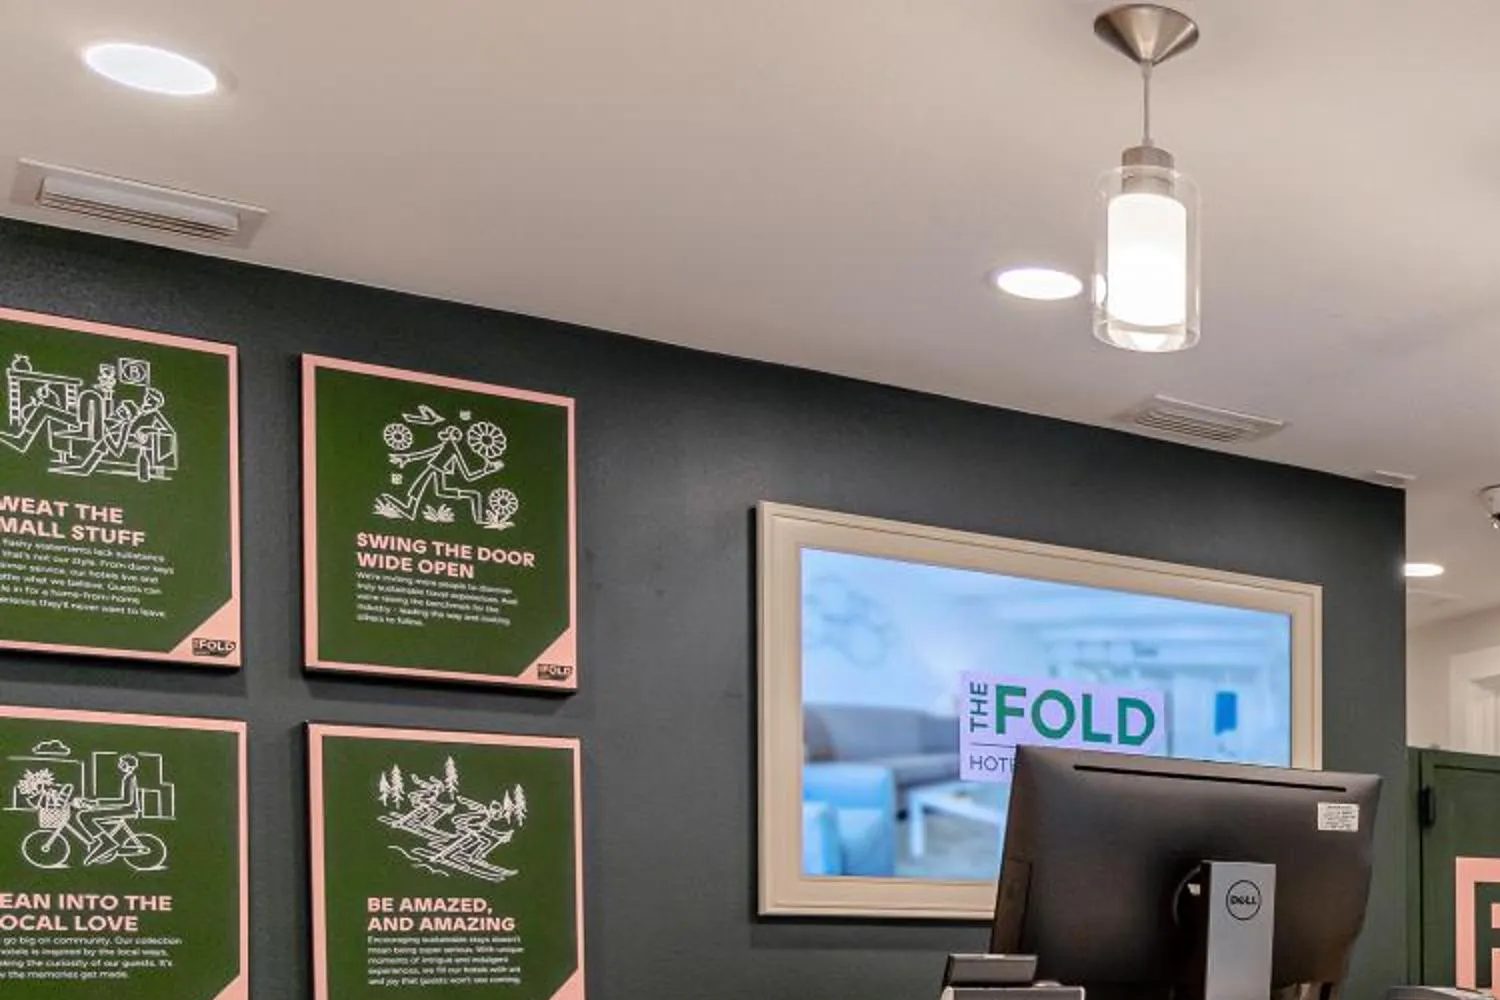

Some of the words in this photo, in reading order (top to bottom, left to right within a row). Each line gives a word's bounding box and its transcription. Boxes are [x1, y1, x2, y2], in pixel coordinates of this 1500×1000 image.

[0, 496, 69, 518] WEAT
[74, 503, 124, 524] THE
[0, 516, 65, 539] MALL
[71, 525, 146, 547] STUFF
[356, 532, 428, 554] SWING
[431, 541, 473, 560] THE
[477, 547, 536, 568] DOOR
[101, 560, 126, 569] From
[356, 552, 413, 572] WIDE
[418, 559, 475, 579] OPEN
[89, 570, 119, 580] hotels
[25, 586, 39, 595] for
[199, 639, 236, 651] FOLD
[970, 681, 988, 733] THE
[995, 684, 1155, 746] FOLD
[969, 755, 1015, 772] HOT
[0, 893, 51, 910] EAN
[58, 893, 119, 911] INTO
[124, 895, 173, 911] THE
[367, 897, 394, 912] BE
[400, 897, 493, 915] AMAZED,
[0, 914, 68, 931] OCAL
[75, 915, 139, 931] LOVE
[367, 917, 414, 932] AND
[419, 917, 516, 932] AMAZING
[4, 937, 17, 946] go
[20, 936, 37, 947] big
[53, 937, 112, 947] community.
[115, 936, 133, 945] Our
[135, 936, 182, 945] collection
[368, 936, 420, 946] Encouraging
[83, 948, 97, 958] by
[117, 948, 141, 956] local
[45, 960, 88, 969] curiosity
[368, 957, 408, 965] moments
[409, 957, 420, 965] of
[8, 971, 25, 979] the
[27, 971, 79, 979] memories
[80, 971, 97, 981] get
[368, 977, 385, 985] and
[385, 978, 401, 988] joy
